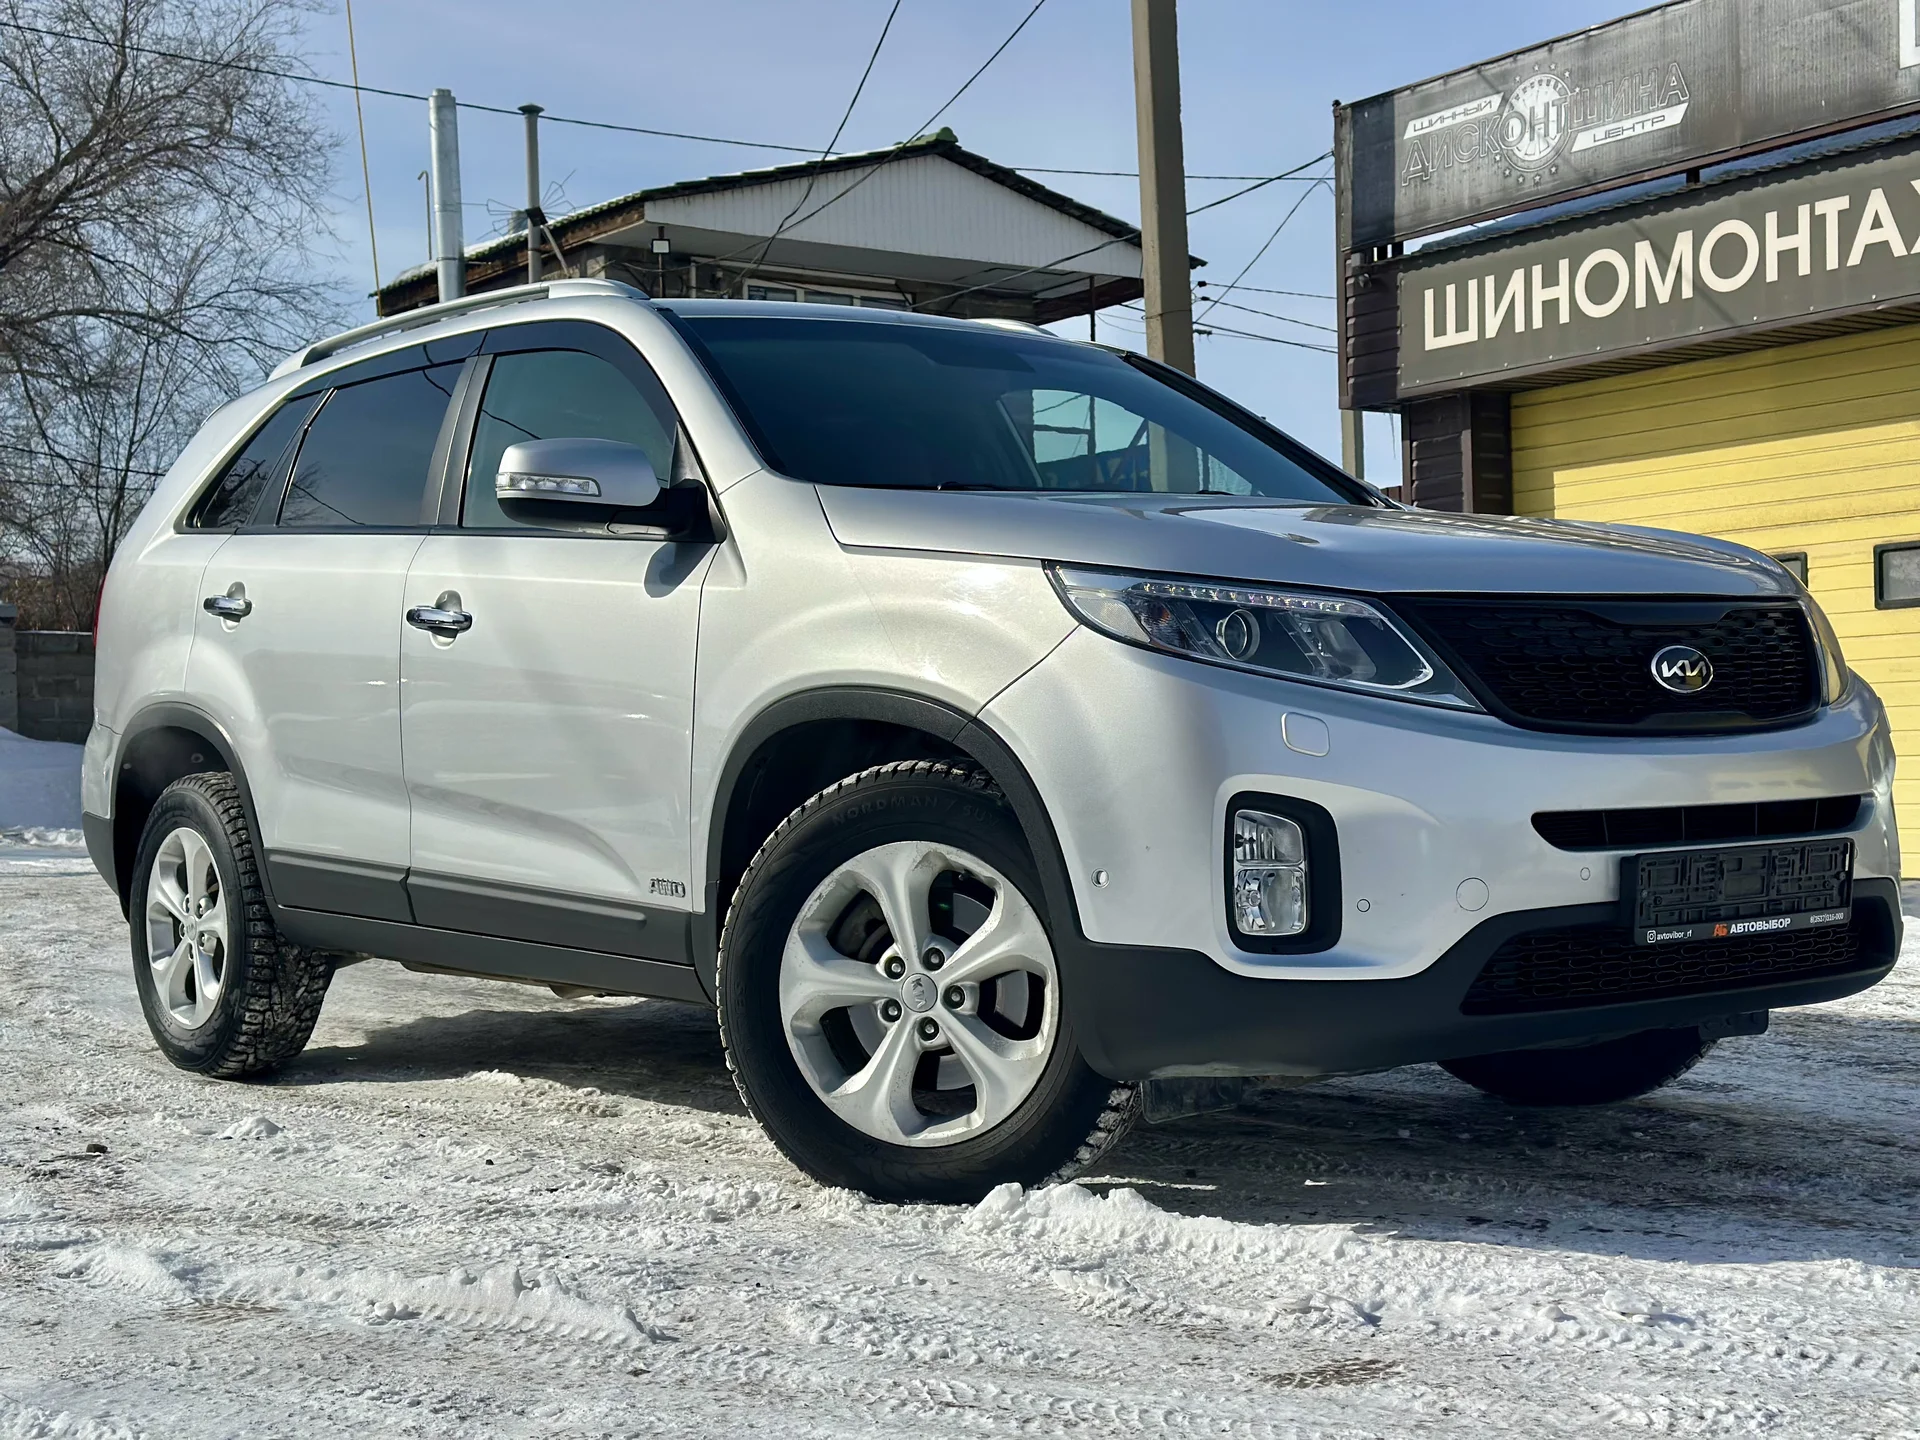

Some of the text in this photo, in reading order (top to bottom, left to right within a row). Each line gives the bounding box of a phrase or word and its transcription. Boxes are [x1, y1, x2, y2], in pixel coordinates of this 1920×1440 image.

[1413, 99, 1494, 132] ШИННЫЙ
[1592, 114, 1667, 143] ЦЕНТР
[831, 795, 938, 826] NORDMAN
[648, 877, 686, 898] AWD
[1656, 929, 1693, 941] avtovibor_rf
[1730, 917, 1792, 934] АВТОВЫБОР
[911, 977, 927, 1009] KIA
